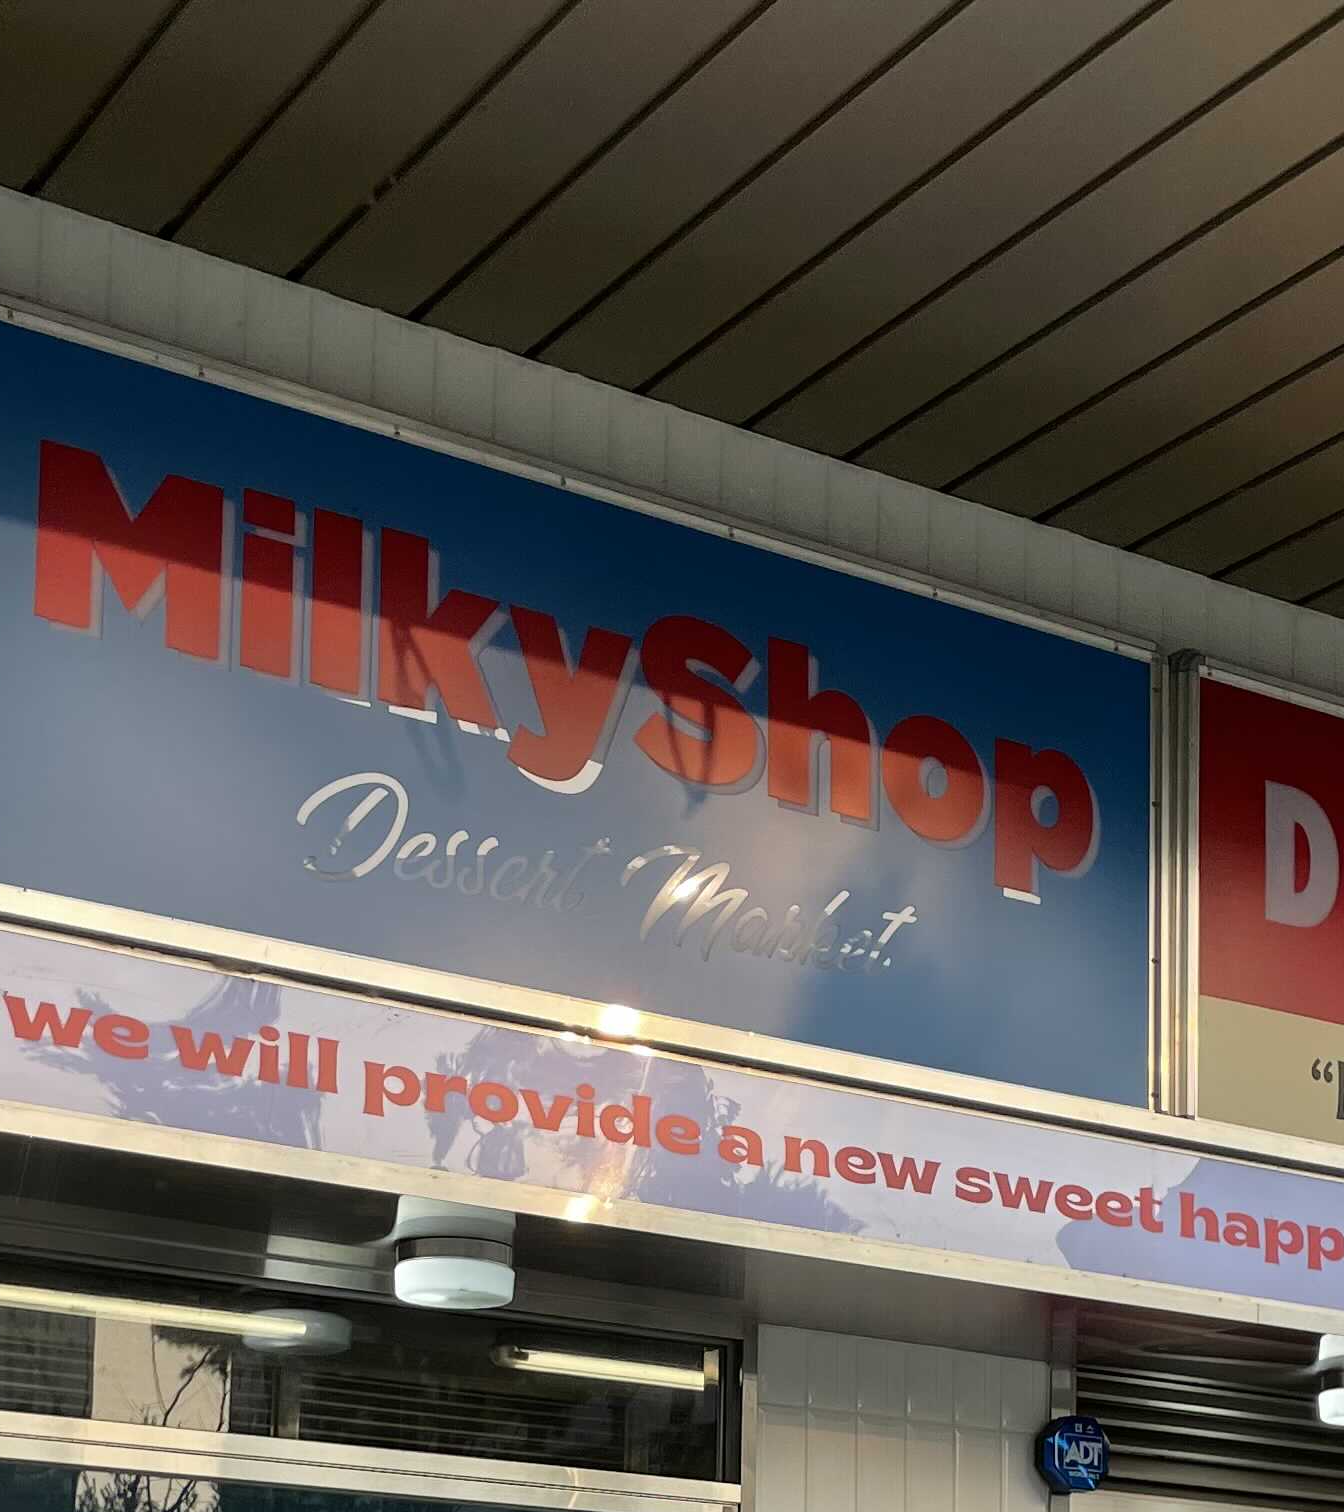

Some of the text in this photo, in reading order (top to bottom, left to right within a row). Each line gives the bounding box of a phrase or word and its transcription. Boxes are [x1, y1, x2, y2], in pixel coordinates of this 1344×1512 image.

[34, 438, 1097, 904] MilkyShop
[295, 771, 920, 976] Dessert Market
[3, 990, 150, 1060] we
[171, 1024, 340, 1095] will
[362, 1058, 702, 1157] provide
[716, 1123, 765, 1168] a
[782, 1132, 942, 1195] new
[954, 1167, 1168, 1233] sweet
[1064, 1440, 1103, 1467] ADT
